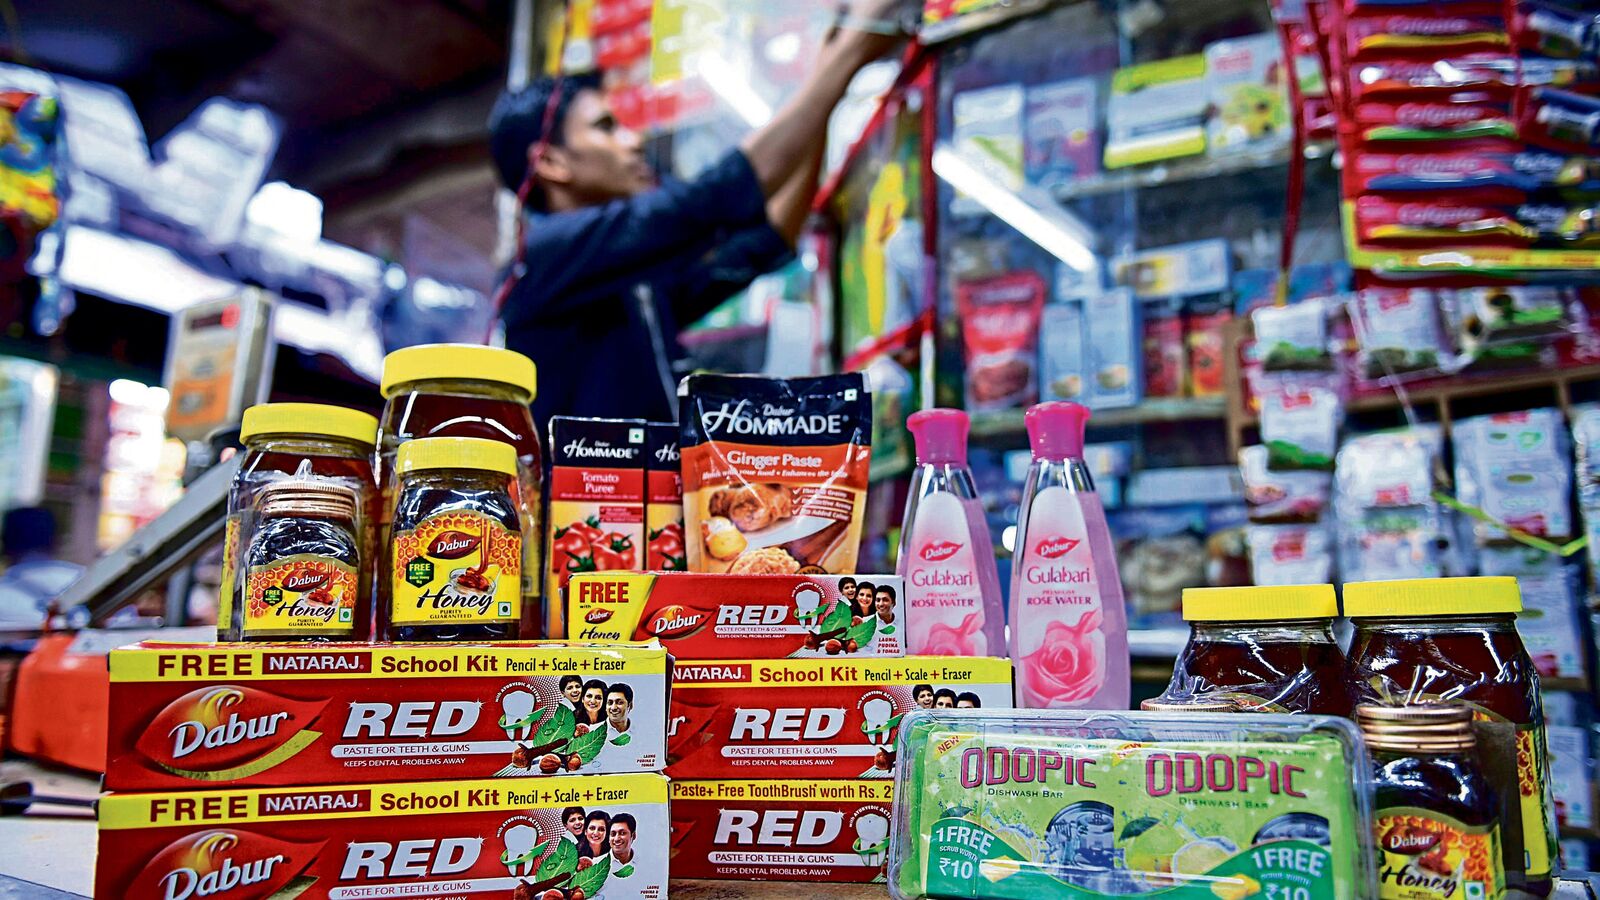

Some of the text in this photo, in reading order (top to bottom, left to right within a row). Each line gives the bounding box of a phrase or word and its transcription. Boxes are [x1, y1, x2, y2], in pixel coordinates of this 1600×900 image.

[727, 450, 822, 469] Ginger Paste
[581, 472, 619, 483] Tomato
[585, 484, 615, 493] Puree
[437, 539, 472, 553] Dabur
[409, 563, 430, 571] FREE
[1027, 566, 1090, 584] Gulabari
[288, 574, 323, 588] Dabur
[912, 568, 972, 587] Gulabari
[417, 584, 494, 615] Honey
[579, 582, 629, 603] FREE
[1027, 597, 1053, 605] ROSE
[276, 599, 336, 622] Honey
[911, 598, 974, 607] ROSE WATER
[588, 611, 609, 621] Dabur
[654, 614, 701, 633] Dabur
[716, 605, 788, 624] RED
[579, 626, 620, 640] Honey
[158, 654, 252, 676] FREE
[381, 656, 458, 673] School
[467, 655, 498, 672] Kit
[506, 657, 536, 672] Pencil
[539, 659, 549, 670] +
[552, 658, 577, 671] Scale
[580, 659, 590, 670] +
[593, 657, 625, 671] Eraser
[760, 667, 824, 682] School
[831, 667, 858, 681] Kit
[865, 669, 891, 681] Pencil
[894, 671, 903, 680] +
[905, 669, 928, 680] Scale
[930, 670, 940, 679] +
[942, 668, 972, 680] Eraser
[526, 684, 541, 703] ACTIVES
[342, 701, 482, 738] RED
[729, 708, 845, 740] RED
[168, 712, 288, 759] Dabur
[937, 735, 960, 754] NEW
[343, 744, 470, 755] PASTE FOR TEETH & GUMS
[369, 759, 400, 767] DENTAL
[402, 758, 442, 766] PROBLEMS
[443, 757, 465, 765] AWAY
[960, 746, 1097, 789] ODOPIC
[1146, 752, 1306, 797] ODOPIC
[673, 784, 714, 796] Paste+
[718, 784, 744, 797] Free
[820, 785, 854, 798] worth
[859, 786, 879, 798] Rs.
[988, 787, 1063, 798] DISHWASH BAR
[150, 795, 248, 822] FREE
[381, 791, 458, 811] School
[468, 789, 499, 807] Kit
[507, 790, 538, 805] Pencil
[541, 792, 552, 803] +
[554, 789, 580, 803] Scale
[583, 790, 594, 801] +
[596, 788, 629, 801] Eraser
[1179, 797, 1268, 809] DISHWASH BAR
[502, 815, 527, 828] AYURVEDIC
[528, 817, 544, 837] ACTIVES
[713, 809, 843, 845] RED
[1391, 835, 1433, 849] Dabur
[339, 837, 483, 879] RED
[745, 854, 763, 862] FOR
[807, 855, 835, 863] GUMS
[960, 848, 978, 863] WORTH
[158, 854, 283, 900] Dabur
[939, 857, 973, 879] ₹10
[342, 888, 371, 897] PASTE
[375, 887, 395, 895] FOR
[398, 885, 429, 893] TEETH
[443, 882, 471, 891] GUMS
[1382, 864, 1456, 898] Honey
[1266, 882, 1310, 900] ₹10
